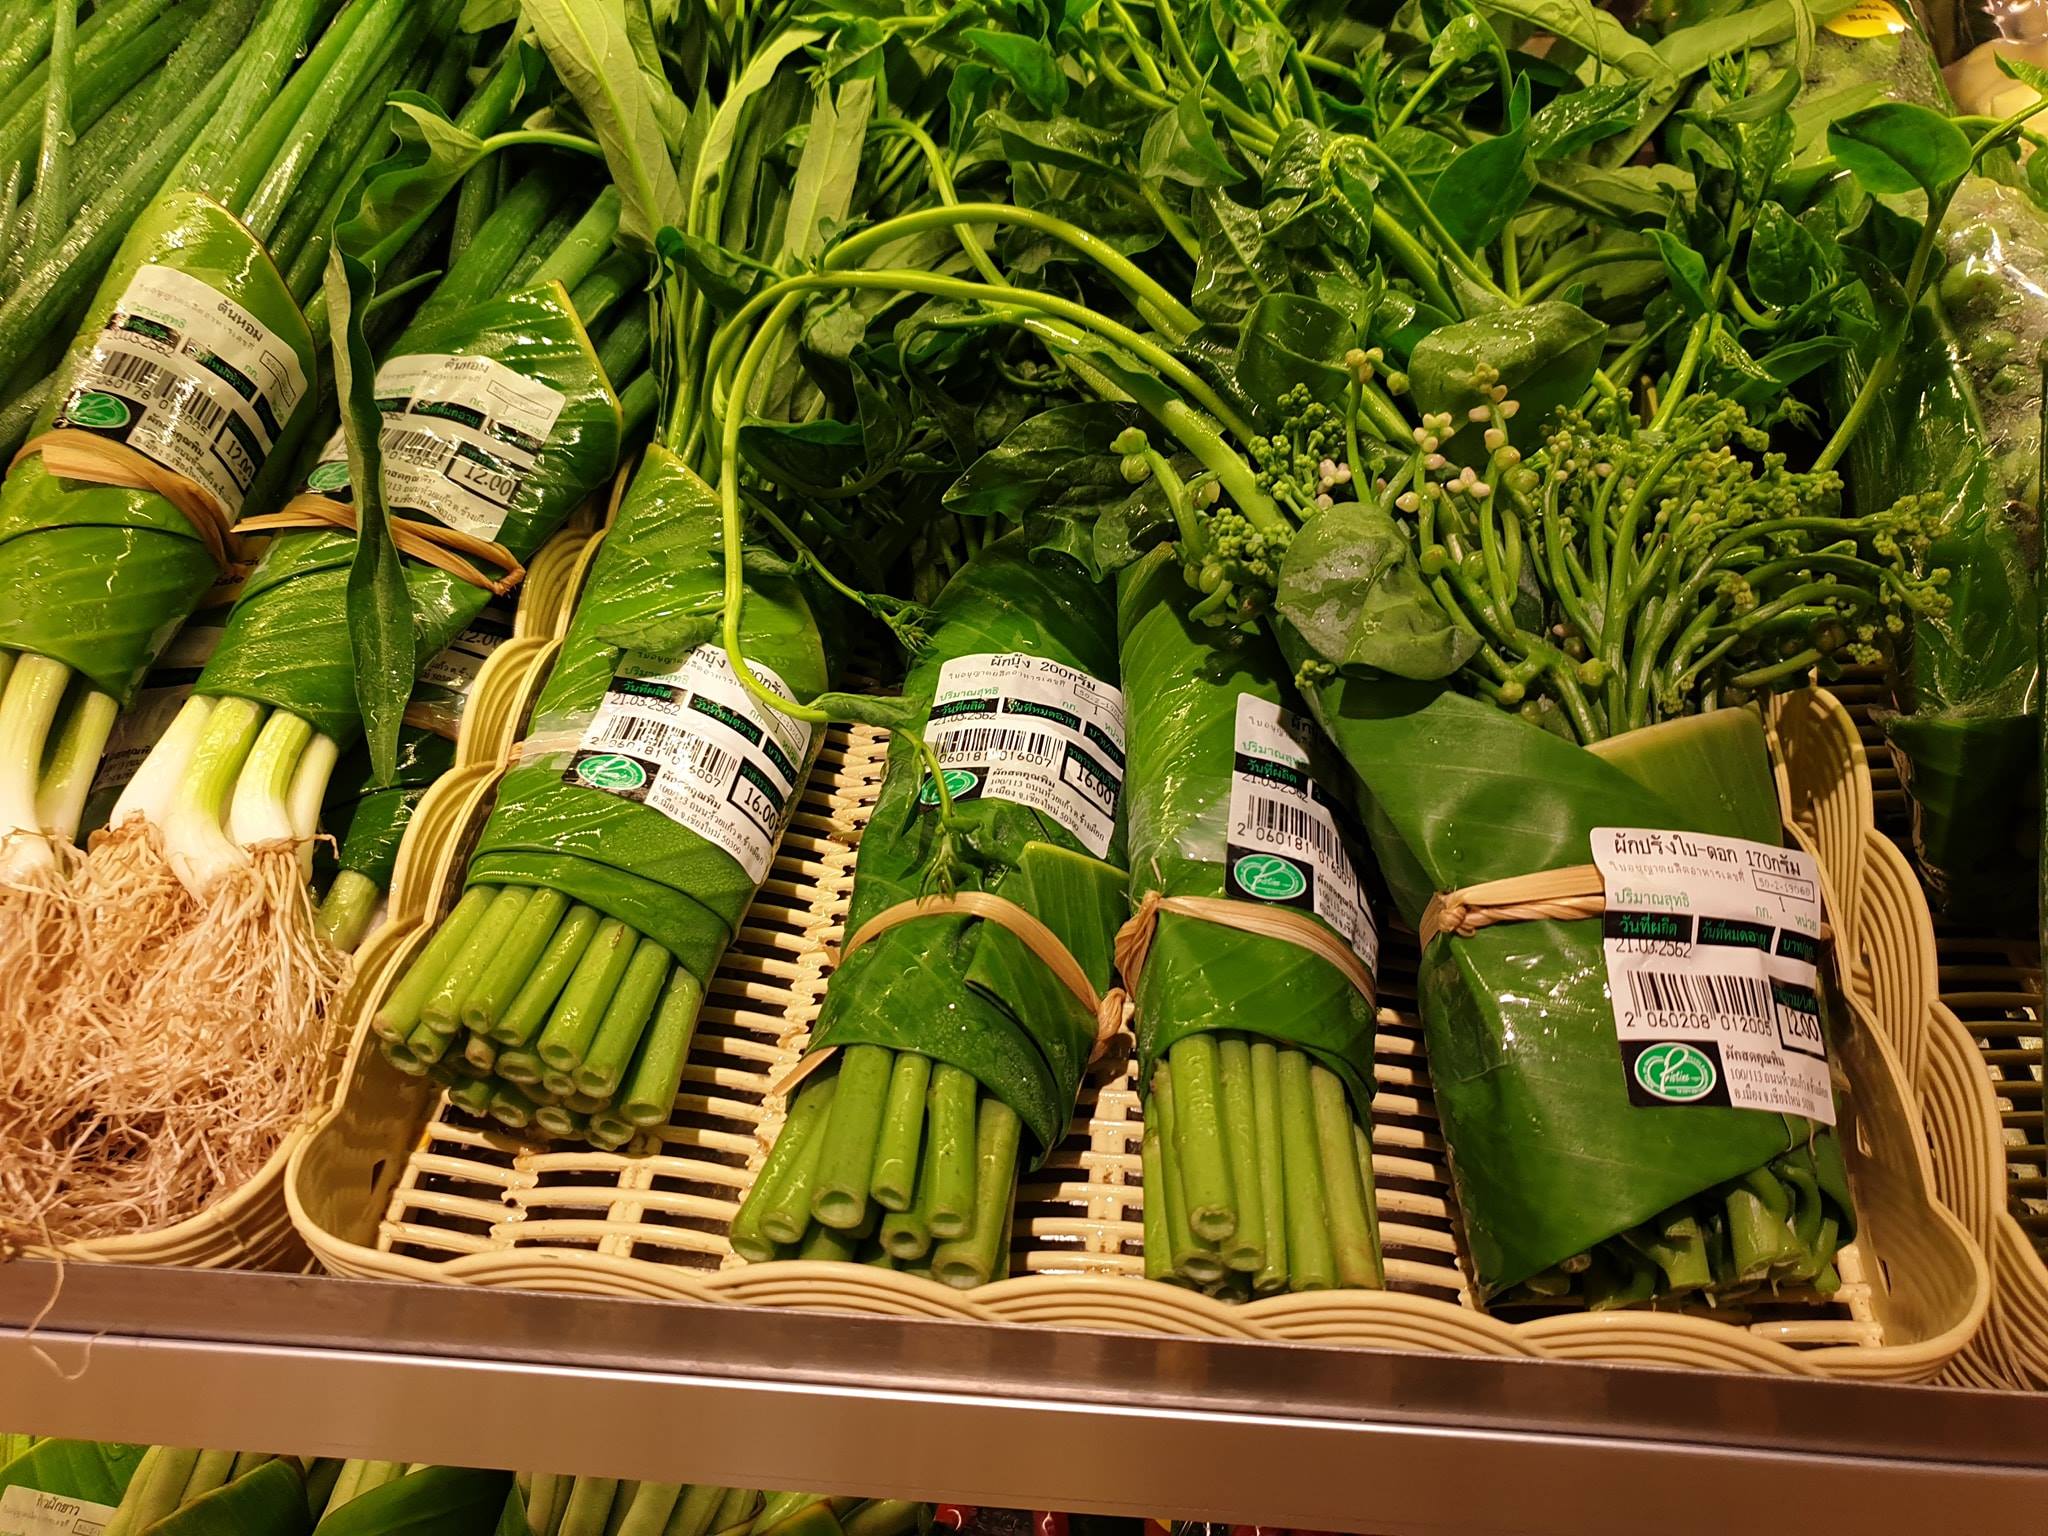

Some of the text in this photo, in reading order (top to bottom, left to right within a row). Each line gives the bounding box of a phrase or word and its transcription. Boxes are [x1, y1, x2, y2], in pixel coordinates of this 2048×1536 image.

[464, 462, 513, 497] 12.00
[1040, 661, 1096, 692] 200กรัม
[611, 693, 681, 717] 21.03.2562
[590, 736, 600, 746] 2
[999, 750, 1052, 769] 016007
[1076, 763, 1113, 806] 16.00
[744, 787, 776, 831] 16.00
[1236, 822, 1247, 837] 2
[1256, 826, 1310, 855] 060181
[1745, 849, 1801, 877] 170กรัม
[1615, 936, 1692, 959] 21.03.2562
[1624, 1011, 1773, 1037] 2 060208 012005
[1785, 1007, 1819, 1042] 12.00
